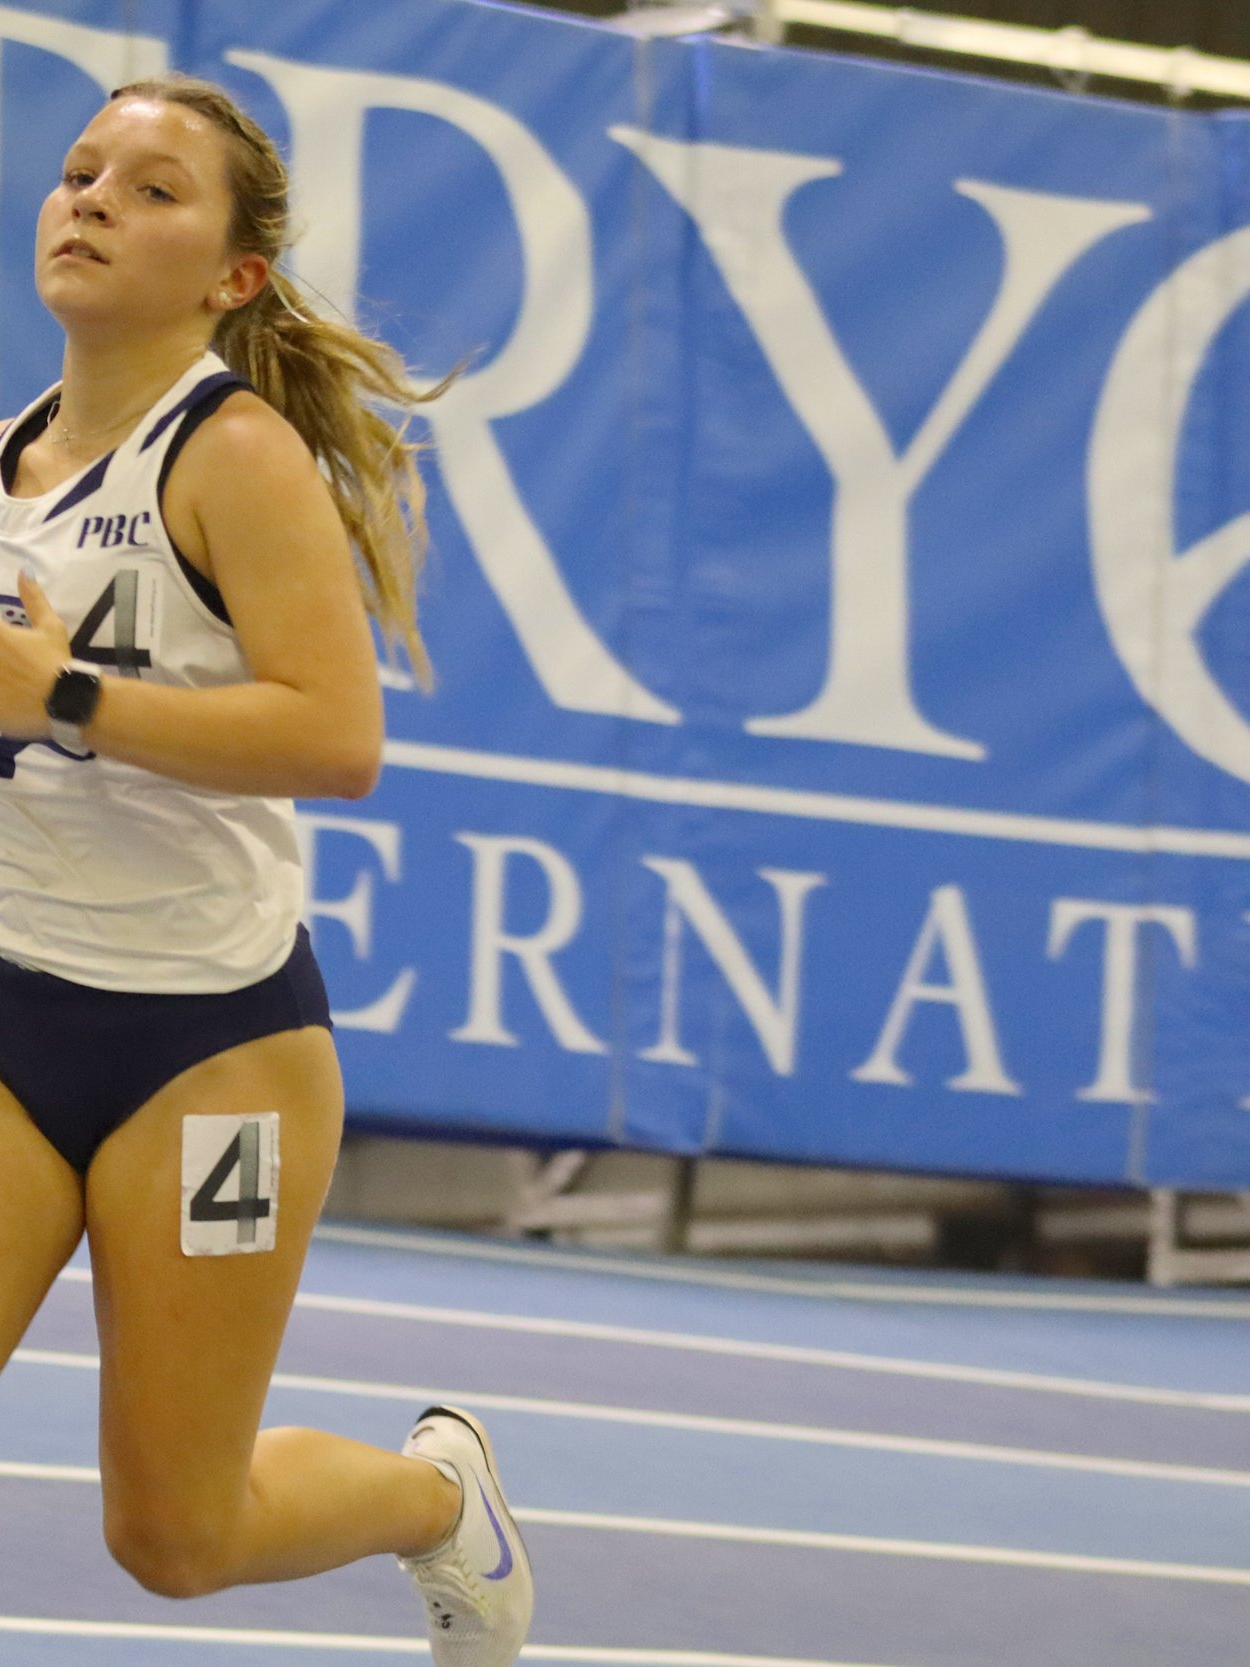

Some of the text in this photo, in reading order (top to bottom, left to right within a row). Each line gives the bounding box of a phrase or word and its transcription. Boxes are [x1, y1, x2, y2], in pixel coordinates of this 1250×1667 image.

[76, 510, 151, 549] PBC
[68, 568, 152, 680] 4
[189, 1120, 271, 1245] 4
